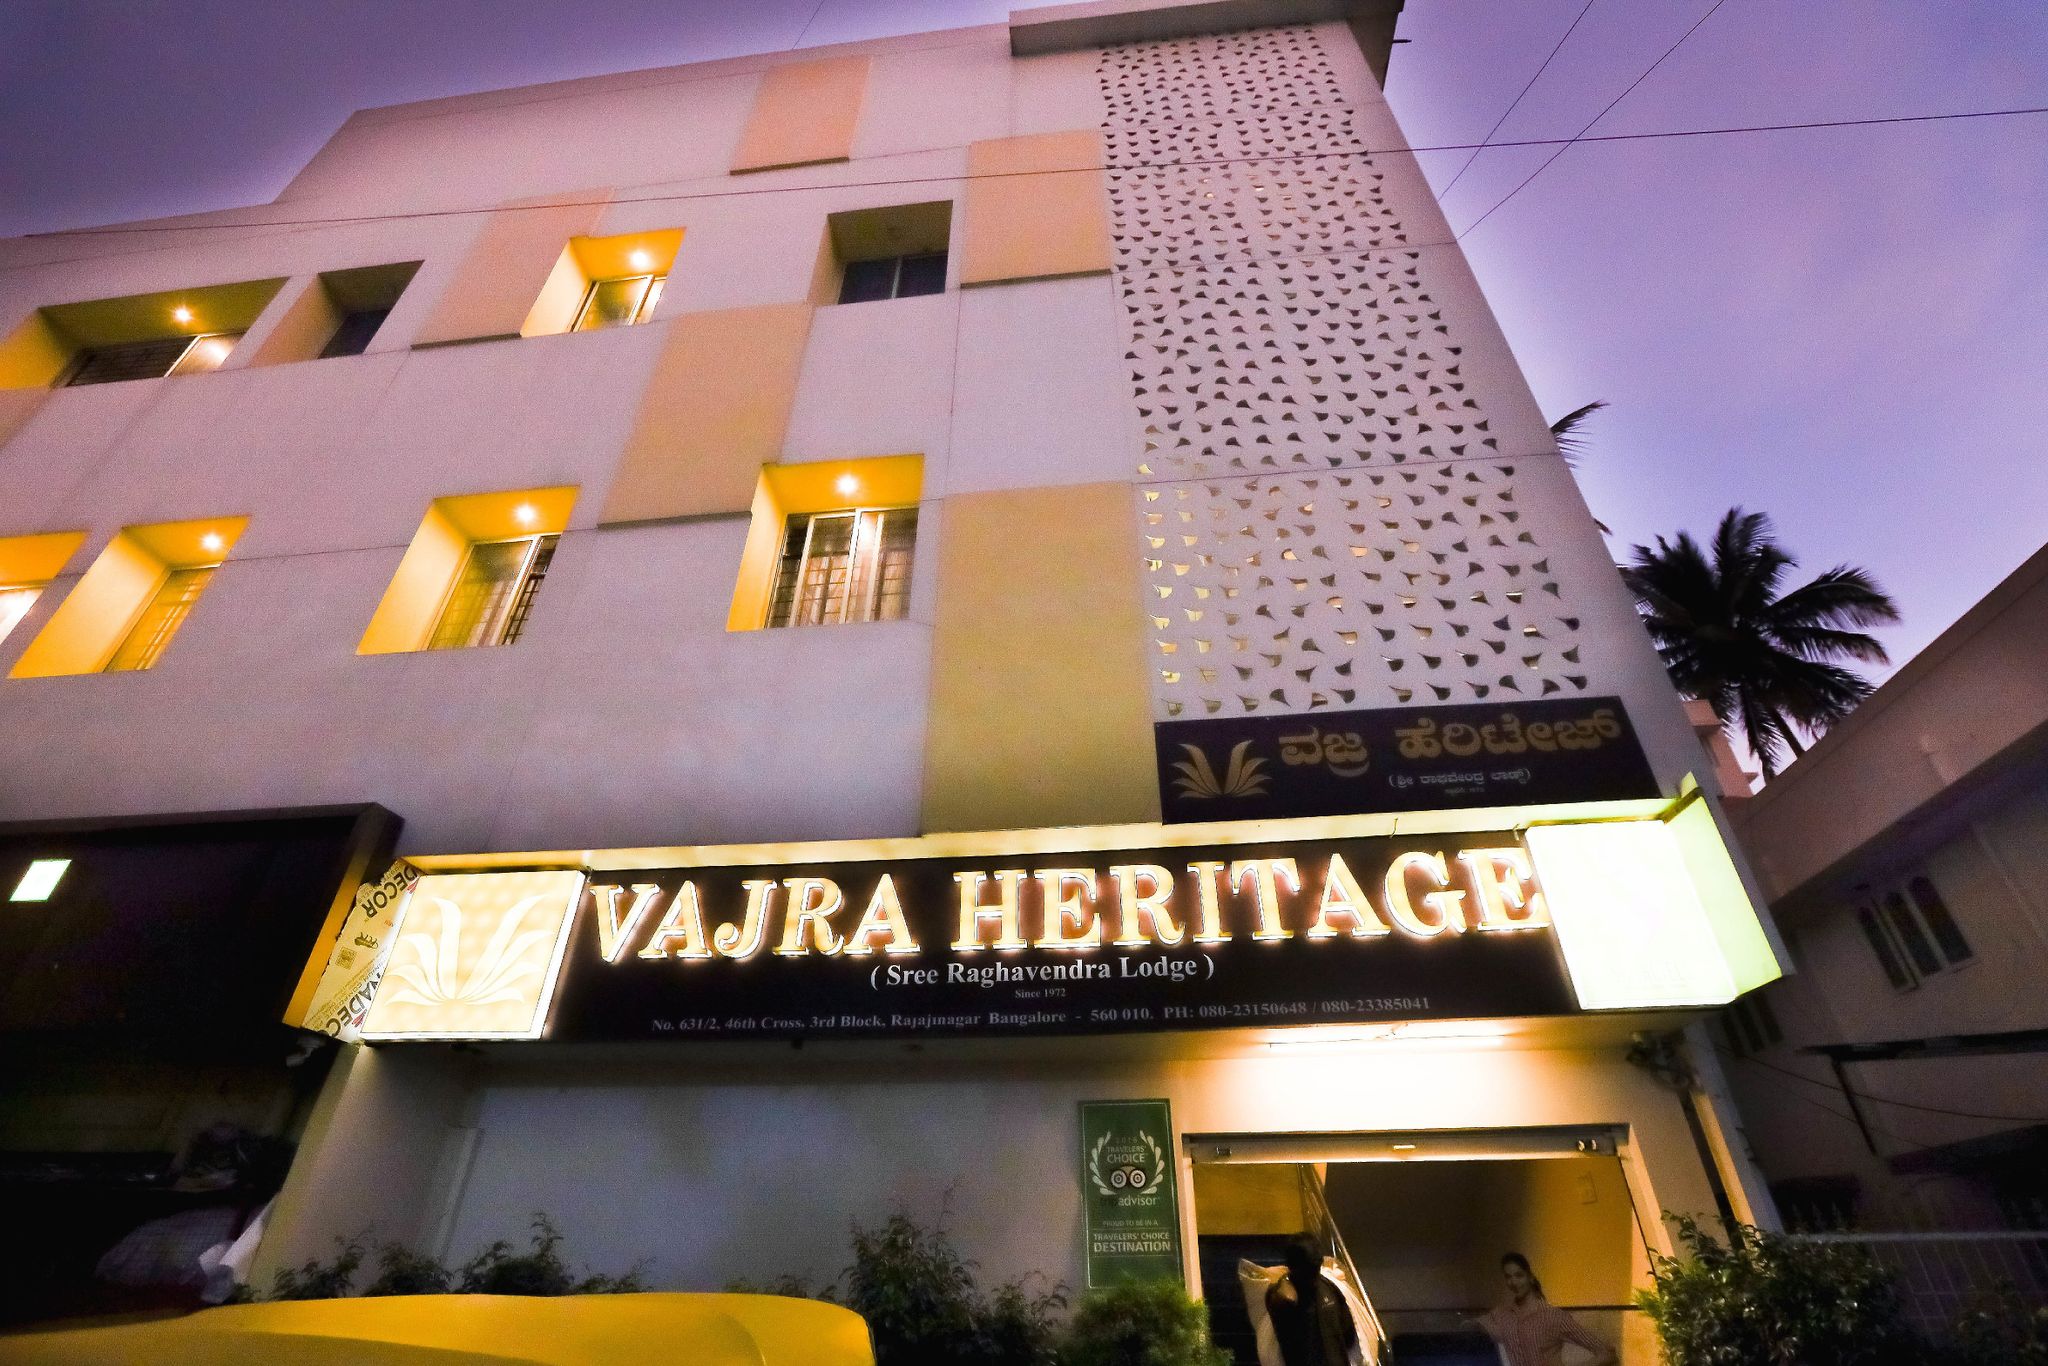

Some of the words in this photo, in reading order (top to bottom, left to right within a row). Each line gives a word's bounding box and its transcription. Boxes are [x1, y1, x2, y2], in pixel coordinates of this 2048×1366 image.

[1278, 726, 1369, 777] ವಜ್ರ
[1394, 709, 1622, 758] ಹೆರಿಟೇಜ್
[589, 873, 921, 963] VAJRA
[951, 847, 1552, 952] HERITAGE
[947, 958, 1111, 988] Raghavendra
[1015, 988, 1040, 998] Since
[1044, 987, 1066, 998] 1972
[724, 1016, 756, 1030] 46th
[809, 1015, 836, 1028] 3rd
[988, 1011, 1067, 1026] Bangalore
[1090, 1008, 1118, 1022] 560
[1163, 1006, 1194, 1019] PH:
[1093, 1240, 1171, 1253] DESTINATION
[1141, 1231, 1170, 1240] CHOICE
